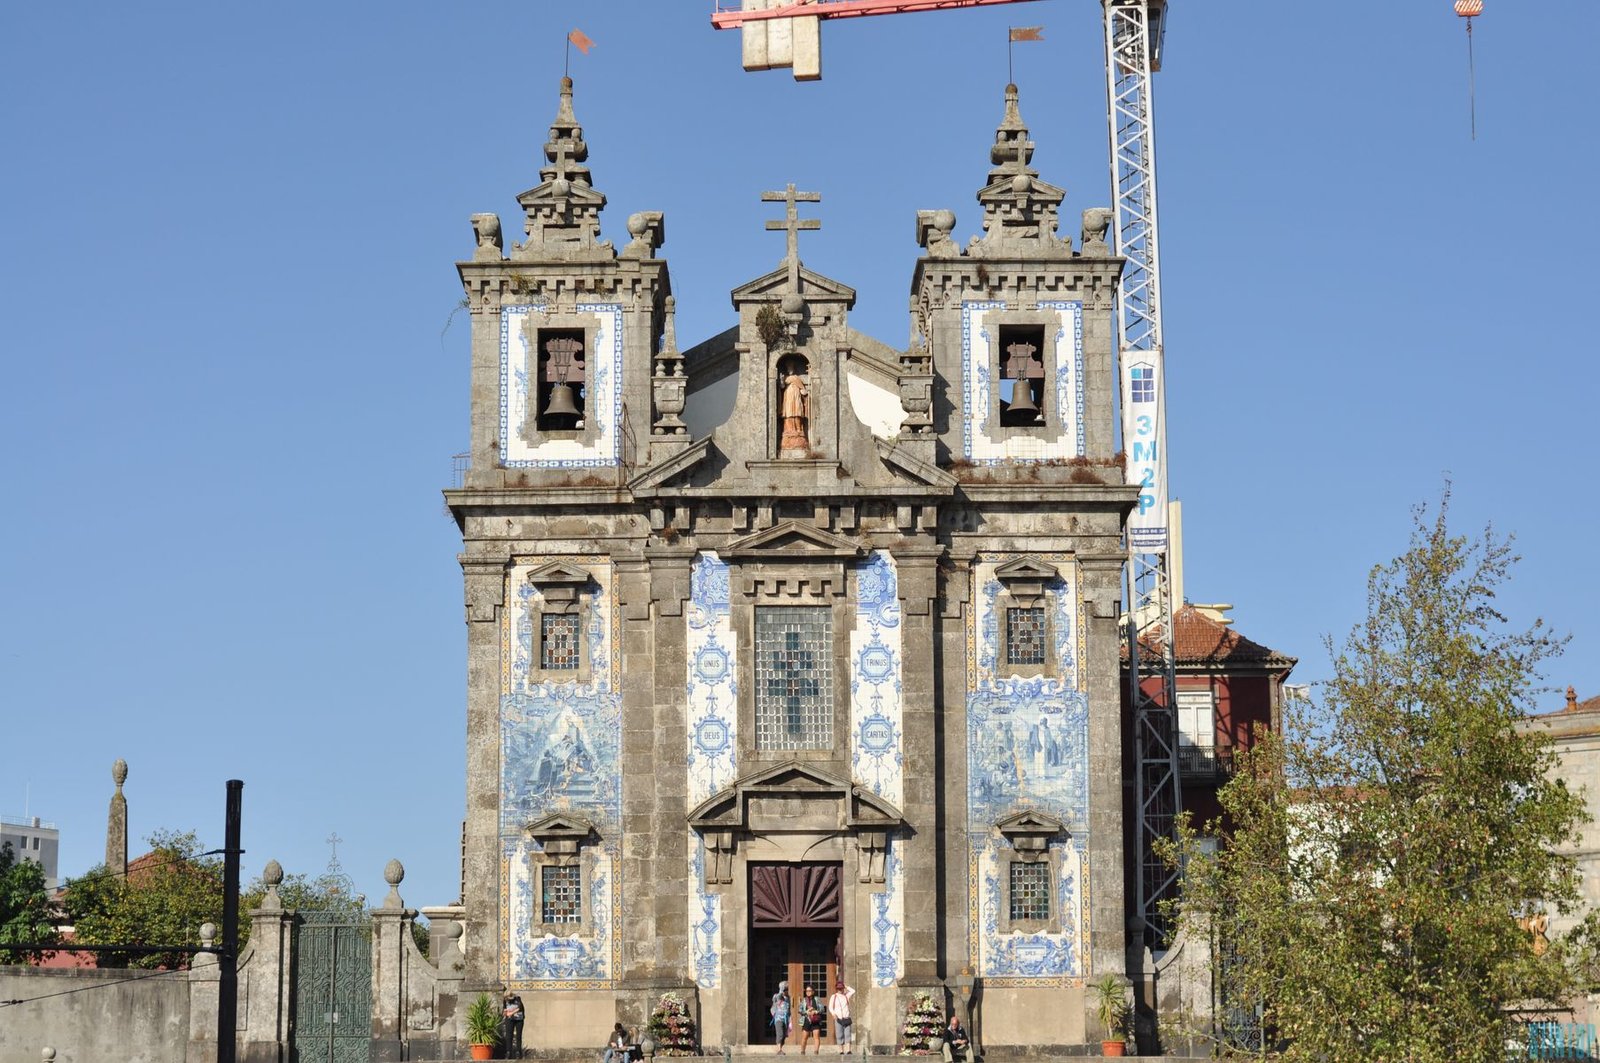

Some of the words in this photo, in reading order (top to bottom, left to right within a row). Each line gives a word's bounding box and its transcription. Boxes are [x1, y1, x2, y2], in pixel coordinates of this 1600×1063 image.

[1133, 415, 1157, 516] 3M2P
[866, 659, 887, 667] TRINUS
[704, 731, 720, 740] DEUS
[866, 730, 887, 739] CARITAS
